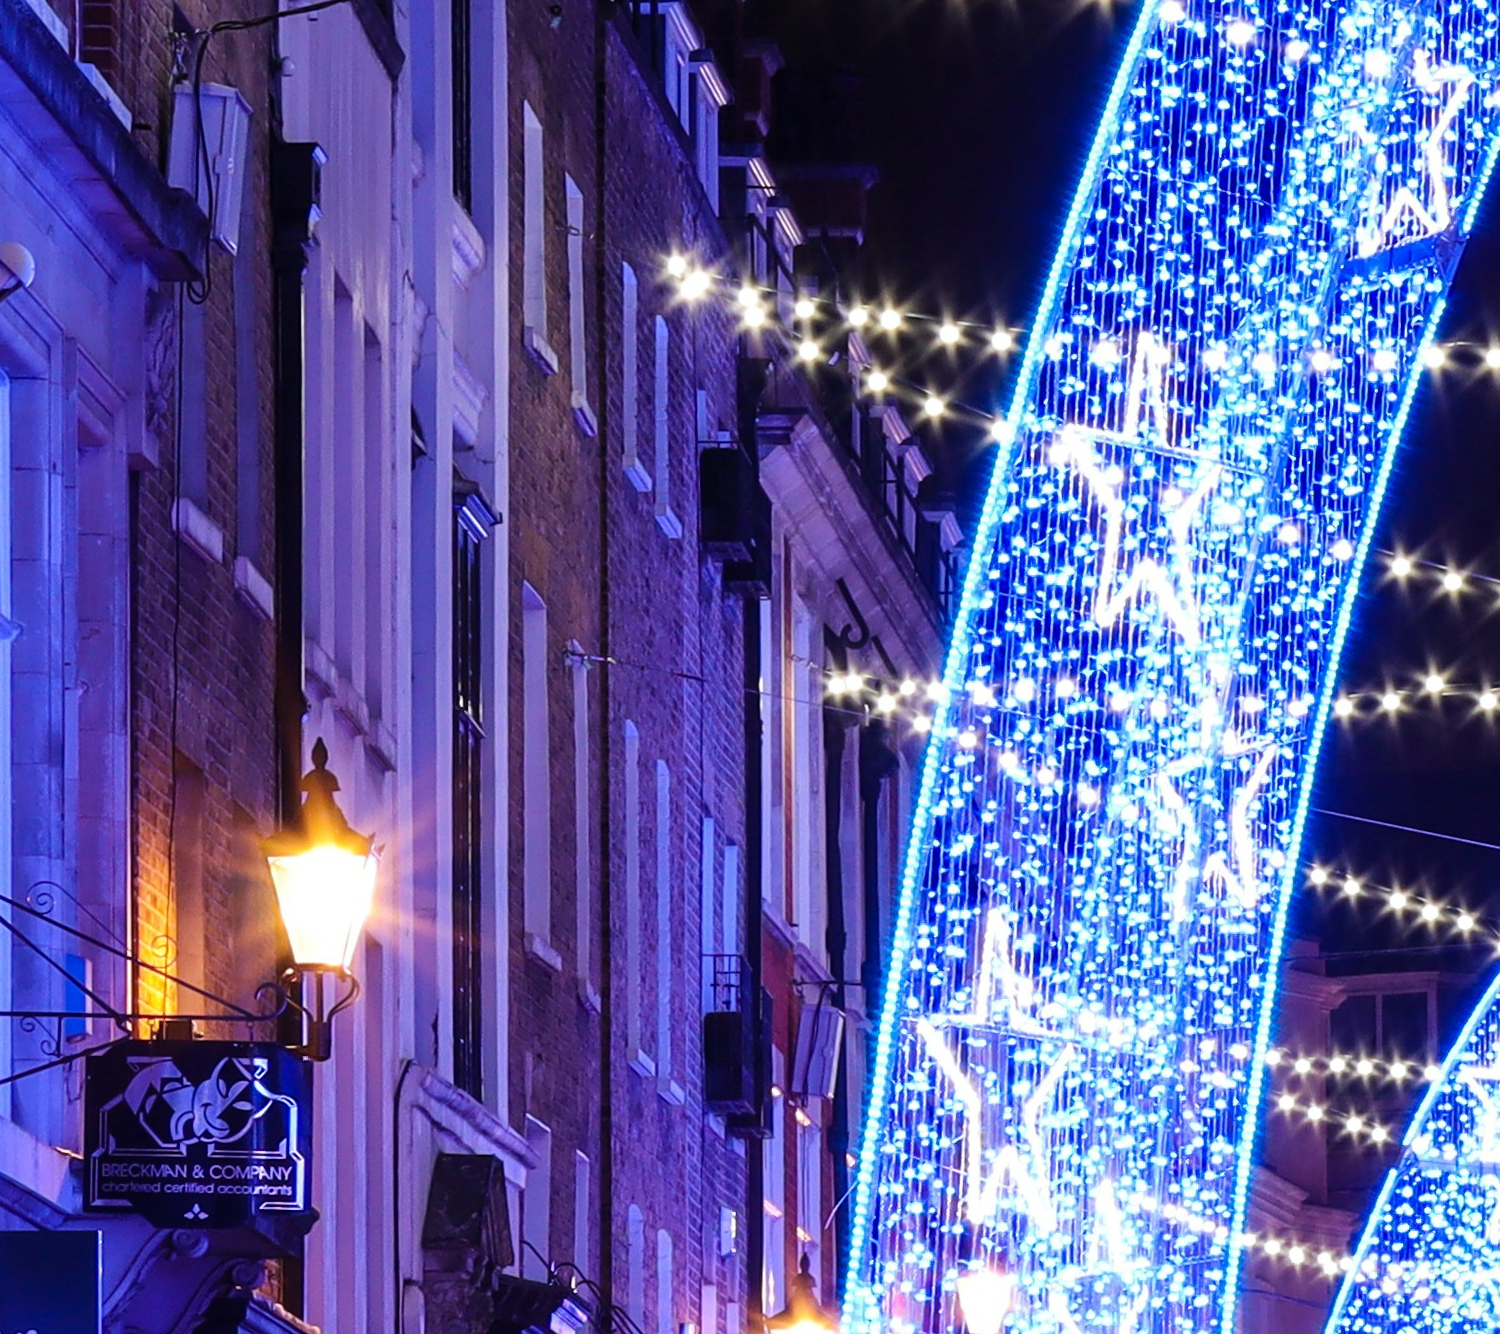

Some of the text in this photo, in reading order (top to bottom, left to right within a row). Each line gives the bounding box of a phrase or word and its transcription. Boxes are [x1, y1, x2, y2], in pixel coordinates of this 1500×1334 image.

[101, 1163, 293, 1181] BRECKMAN & COMPANY
[102, 1181, 293, 1196] chartered certified accountants
